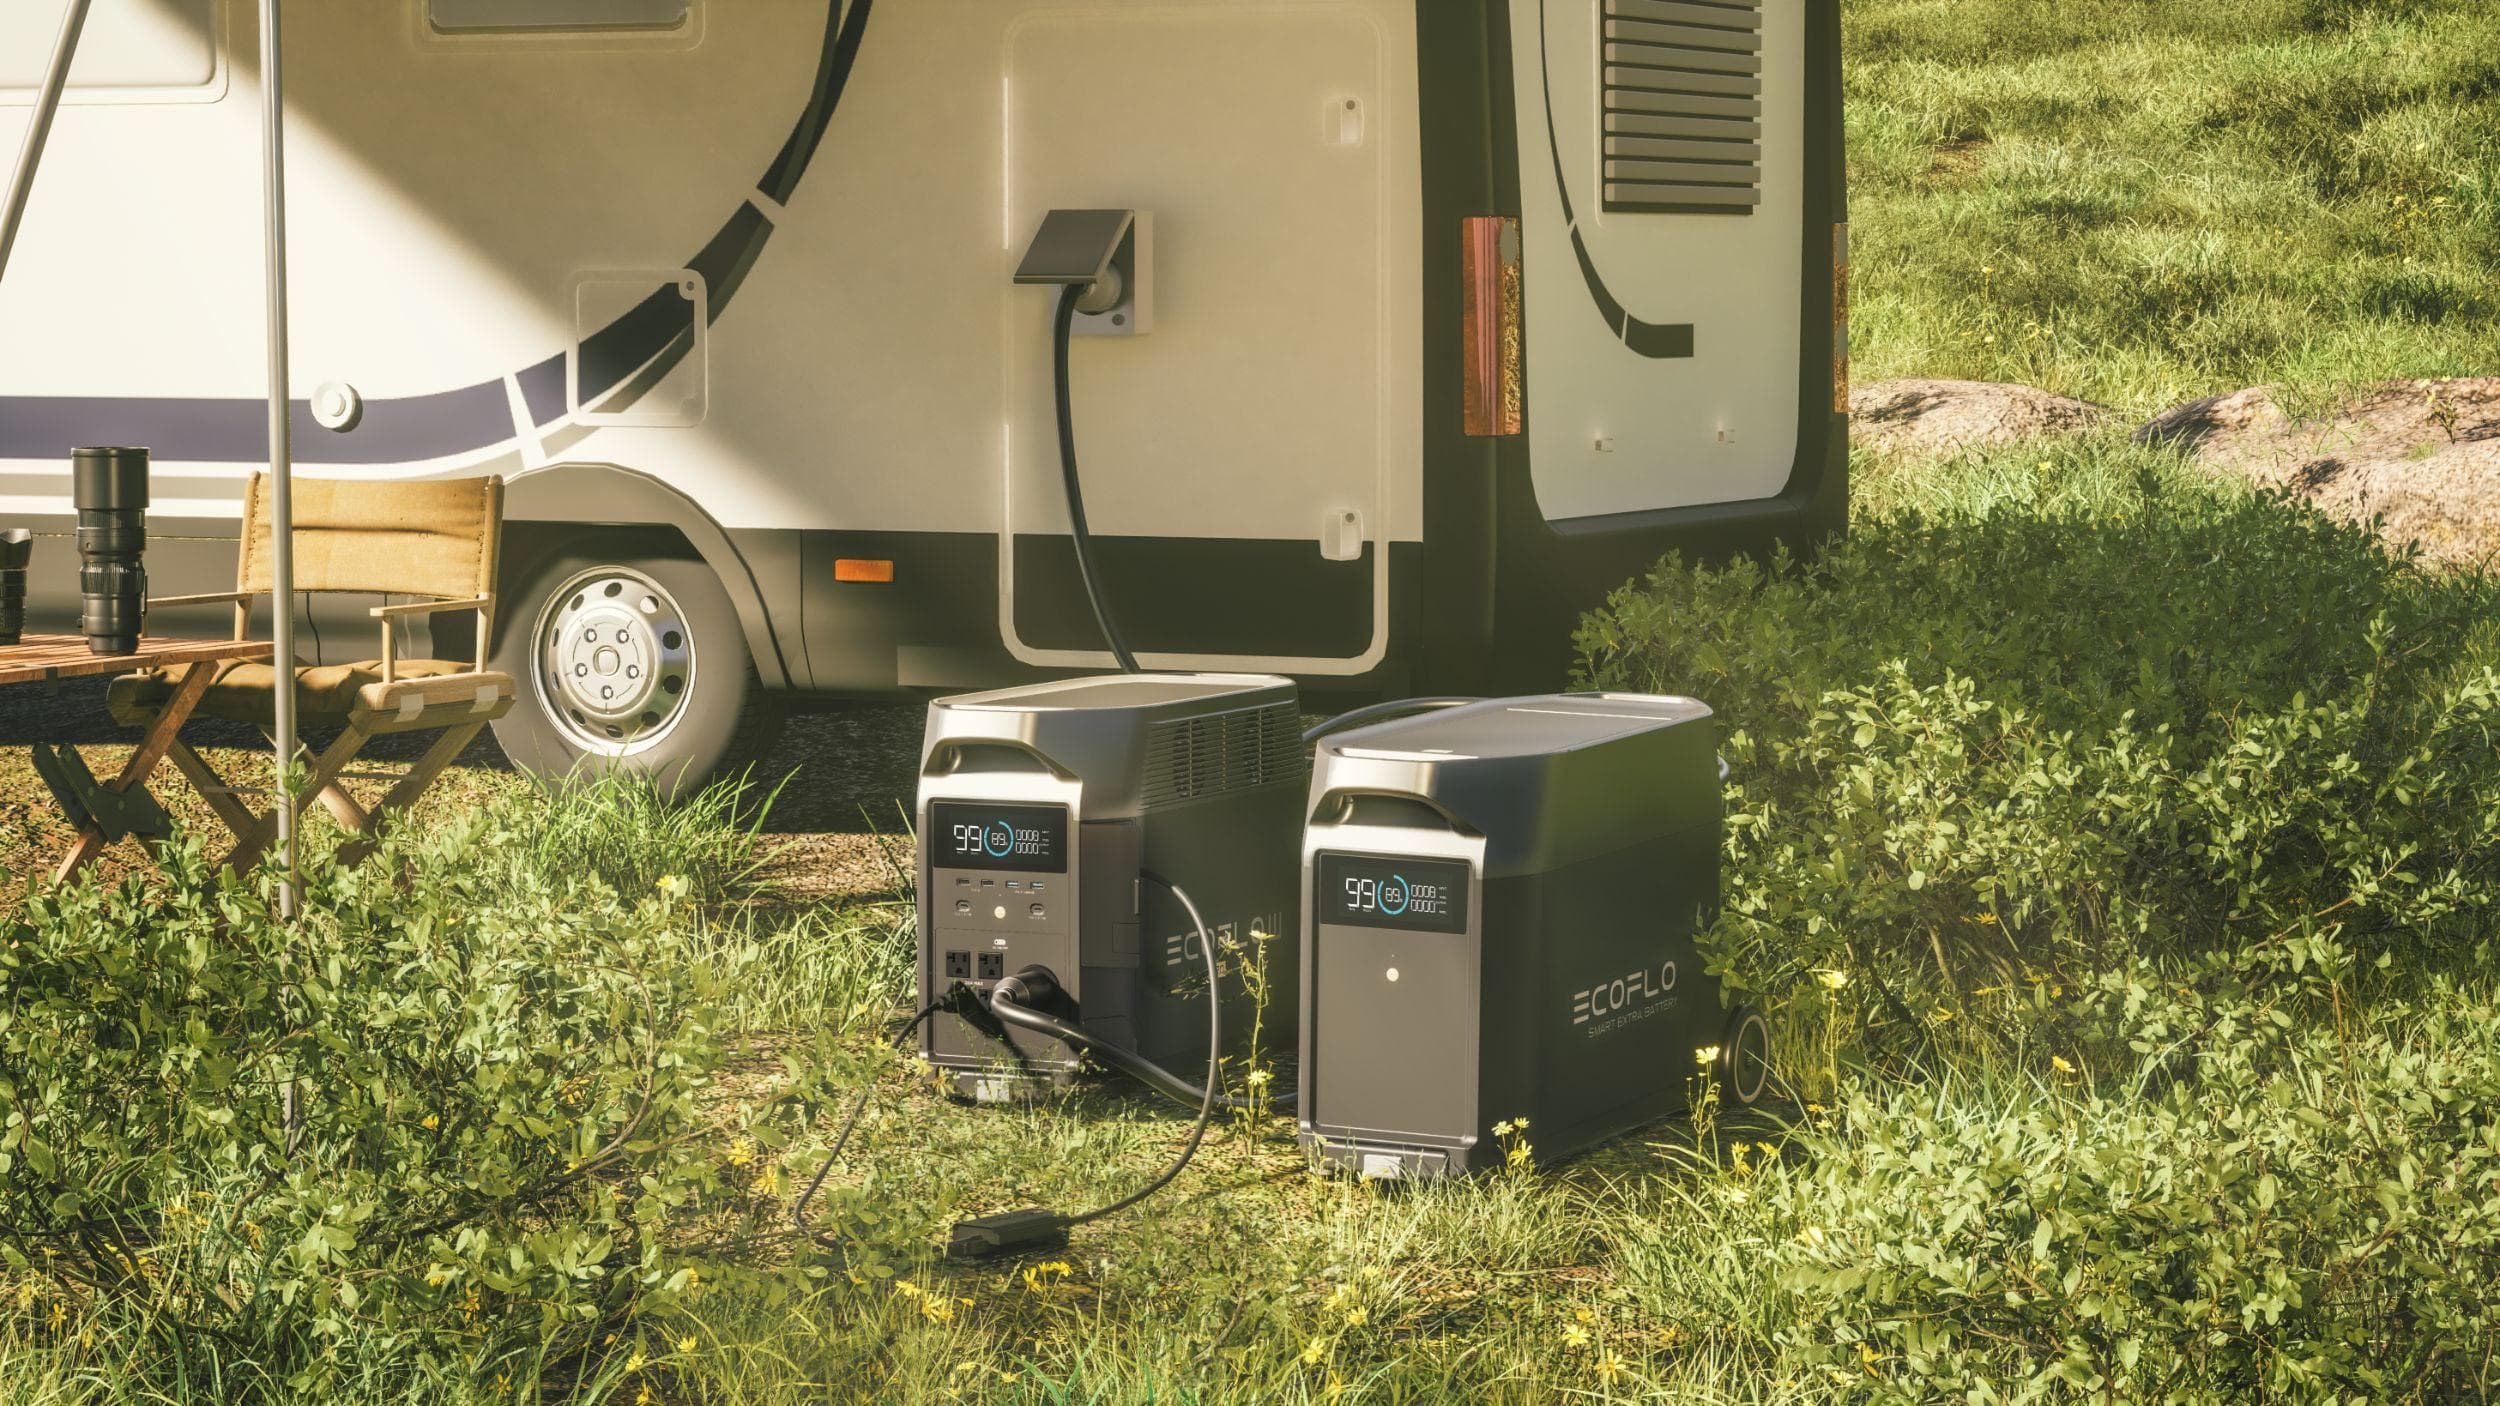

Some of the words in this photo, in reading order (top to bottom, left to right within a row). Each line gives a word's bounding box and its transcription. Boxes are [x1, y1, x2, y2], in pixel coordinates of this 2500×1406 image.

[953, 824, 982, 852] 99
[1345, 877, 1376, 909] 99
[1410, 899, 1436, 913] 0000
[1573, 960, 1677, 1025] ECOFLO
[1587, 1019, 1616, 1039] SMART
[1617, 1009, 1643, 1029] EXTRA
[1644, 997, 1678, 1018] BATTERY
